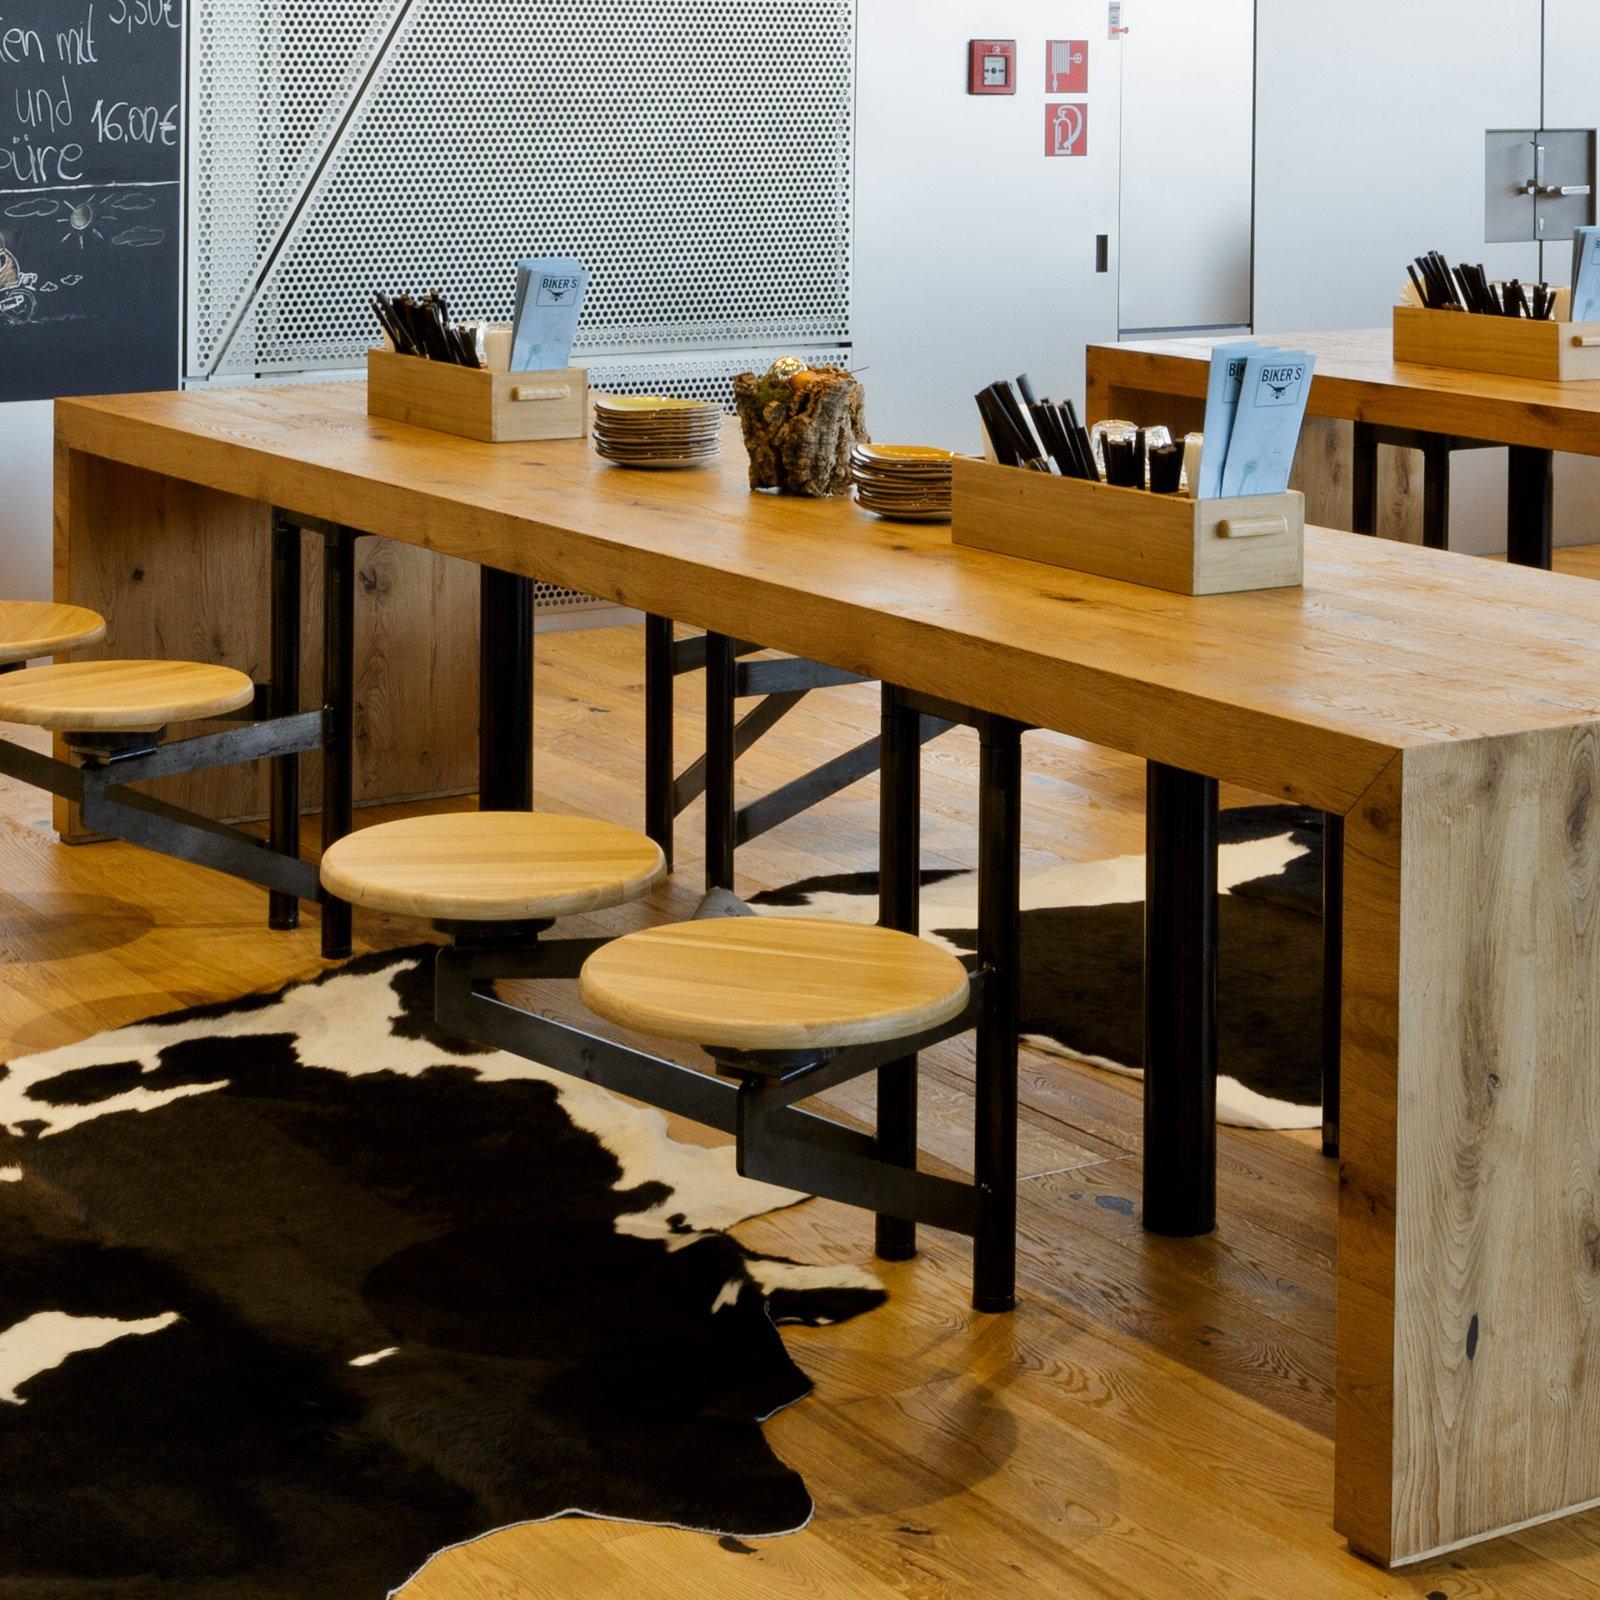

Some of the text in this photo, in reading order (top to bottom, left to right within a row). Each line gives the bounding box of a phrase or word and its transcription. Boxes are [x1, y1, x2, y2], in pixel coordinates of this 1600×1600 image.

[56, 3, 98, 65] mit
[15, 75, 73, 133] und
[542, 277, 578, 289] BIKERS
[1261, 367, 1303, 382] BIKERS
